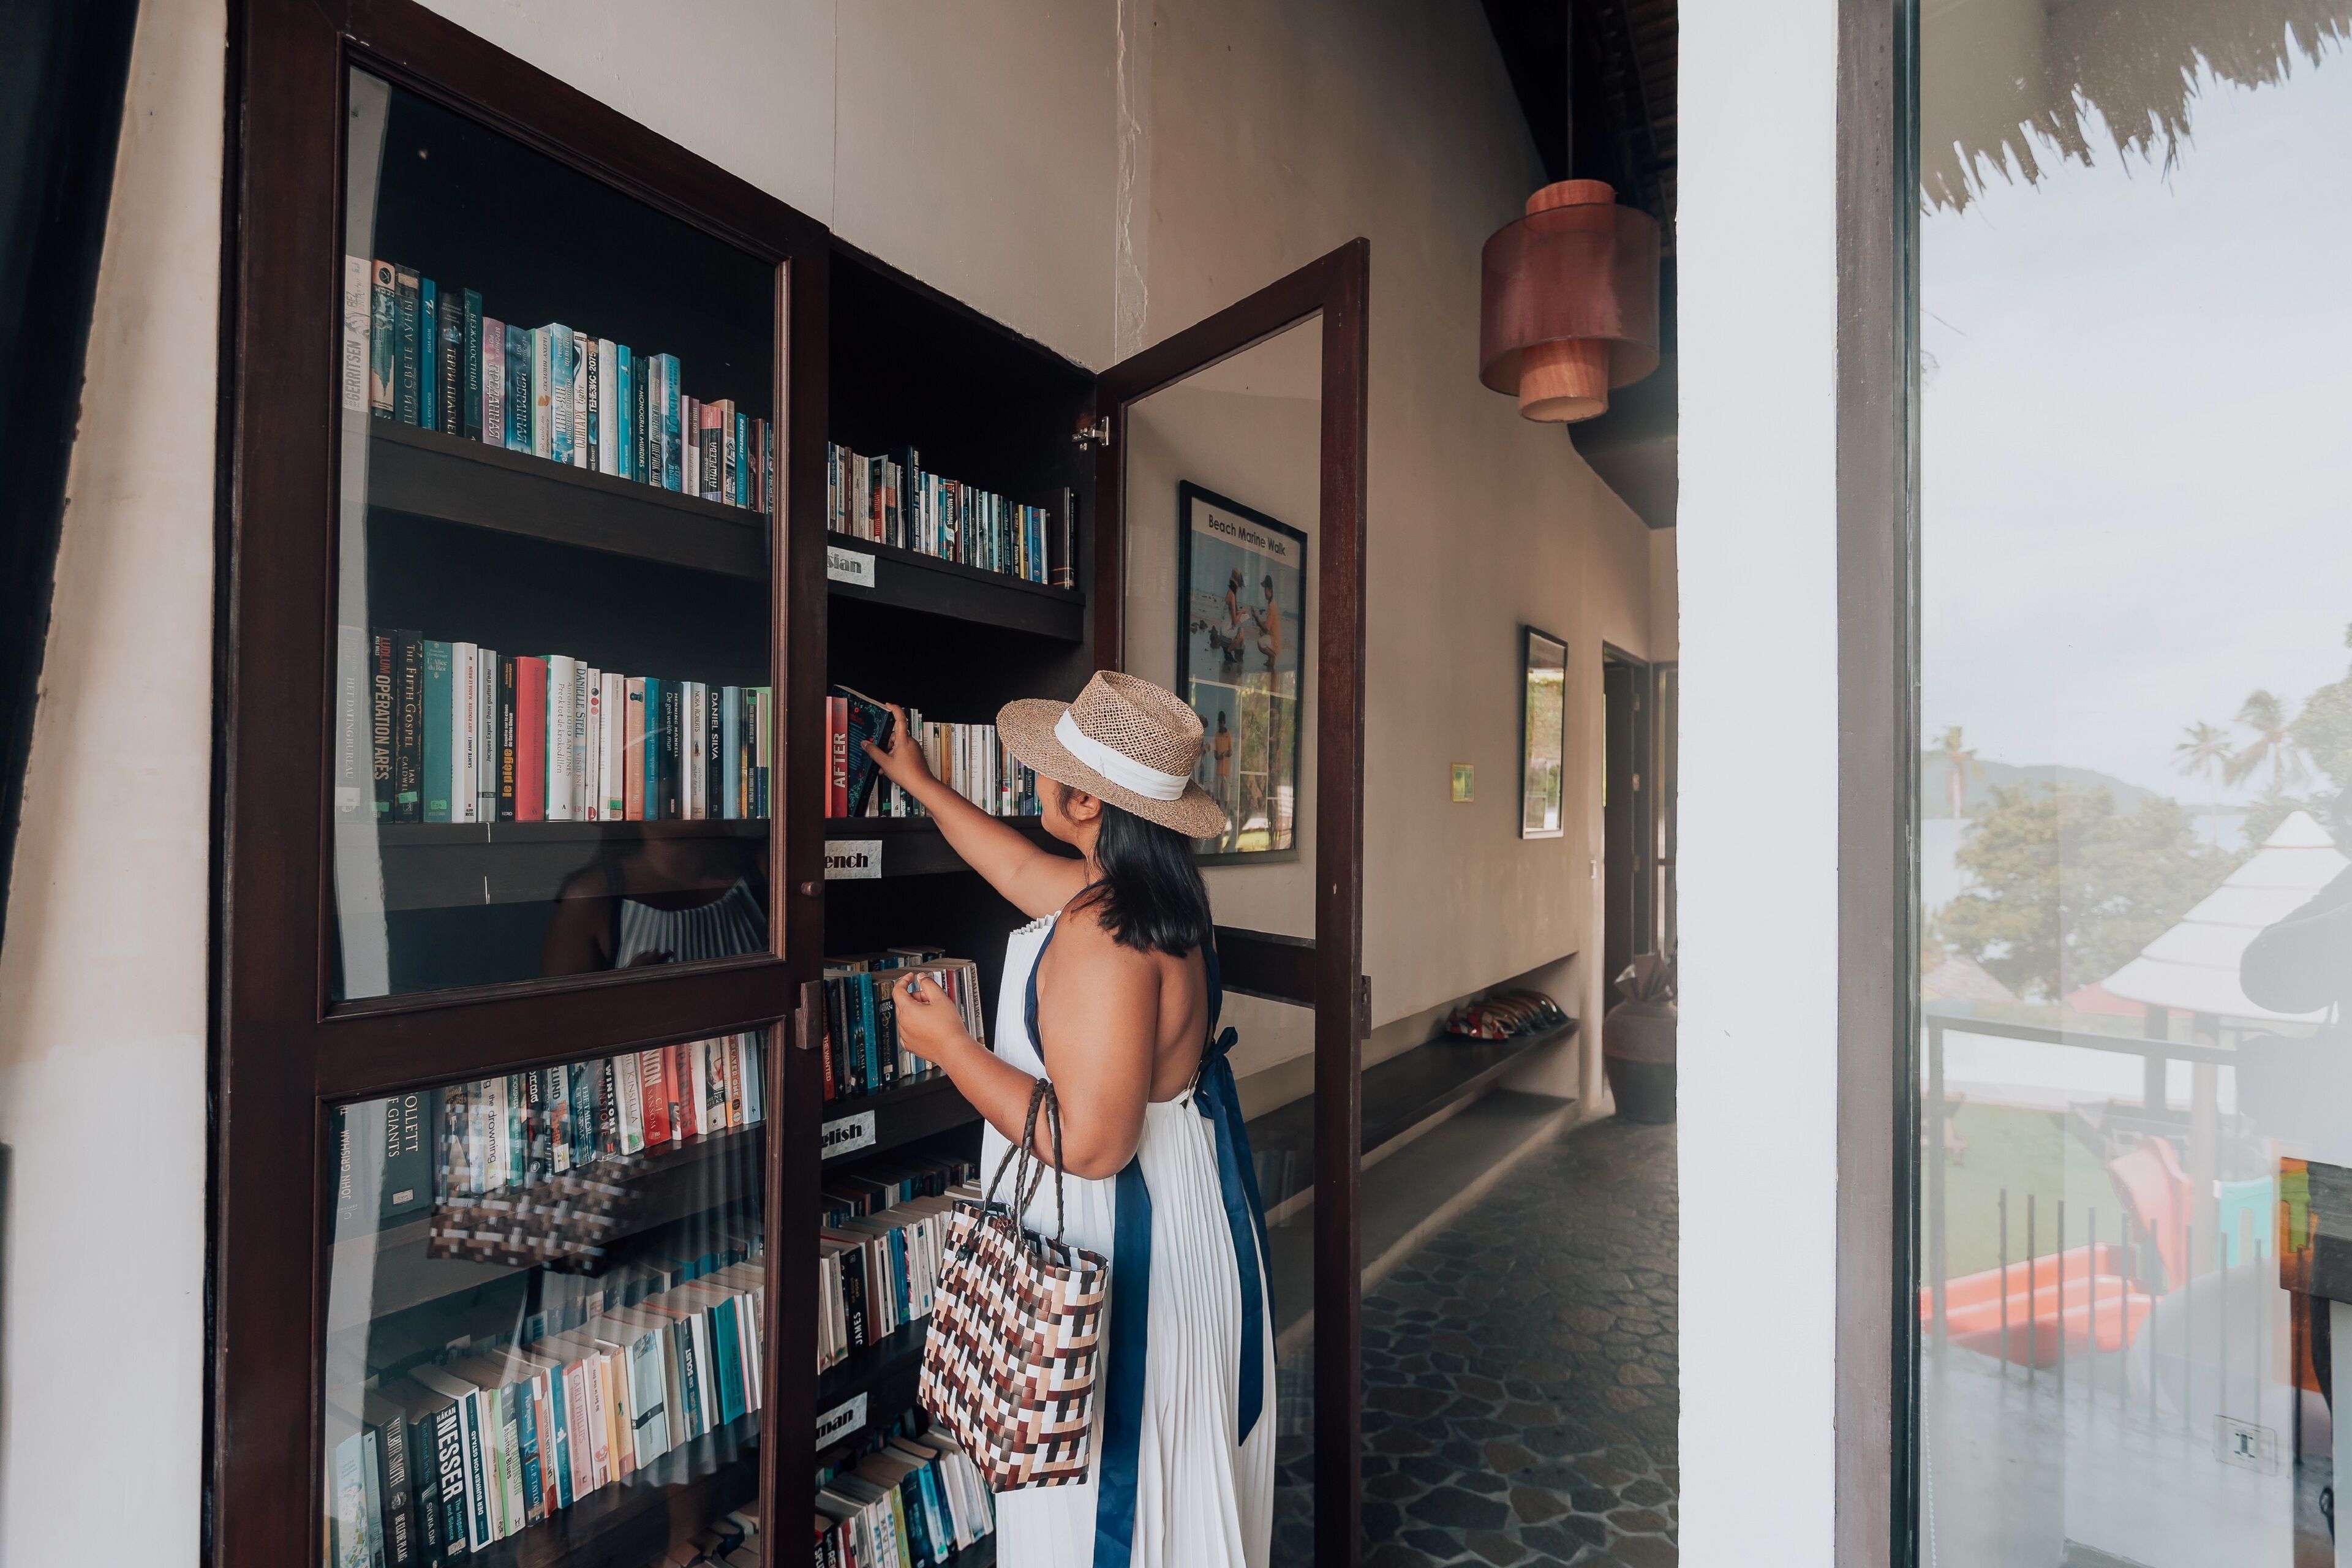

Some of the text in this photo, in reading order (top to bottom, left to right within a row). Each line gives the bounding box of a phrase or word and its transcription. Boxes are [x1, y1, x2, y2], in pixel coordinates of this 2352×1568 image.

[346, 341, 361, 401] GERRITSEN
[404, 300, 413, 424] ПРИ СВЕТЕ ЛУНЫ
[447, 349, 456, 382] ТЕРРИ
[486, 363, 500, 440] ПРЕДАННАЯ
[516, 371, 527, 444] ИЗБРАННАЯ
[555, 385, 566, 433] ИНЬ-ЯН
[575, 409, 586, 448] ОЛИГАРХ
[652, 443, 660, 470] ШЕРЛОК
[1208, 514, 1286, 556] Beach Marine Walk
[379, 637, 391, 674] LUDLUM
[575, 668, 586, 738] DANIELLE STEEL
[666, 692, 673, 703] De
[345, 700, 355, 779] DATINGBUREAU
[374, 675, 394, 780] OPÉRATION ARÈS
[404, 704, 416, 748] GOSPEL
[557, 719, 564, 728] de
[502, 748, 513, 797] le piège
[834, 733, 846, 788] AFTER
[824, 853, 869, 869] ench
[597, 1078, 609, 1136] WINSTONE
[606, 1064, 616, 1135] WINSTONE
[627, 1071, 638, 1124] KINSELLA
[388, 1109, 399, 1157] GIANTS
[405, 1096, 418, 1152] OLLETT
[488, 1110, 498, 1163] drowning
[341, 1129, 351, 1199] JOHN GRISHAM
[854, 1311, 863, 1345] JAMES
[685, 1348, 694, 1376] SOLIST
[573, 1374, 582, 1403] CARLY
[436, 1406, 456, 1423] HÅKAN
[576, 1406, 586, 1444] PHILLIPS
[386, 1417, 405, 1488] WILBUR SMITH
[437, 1415, 464, 1503] NESSER
[509, 1422, 522, 1495] PETER ROBINSON
[395, 1513, 405, 1523] DE
[397, 1540, 407, 1562] PLAAG
